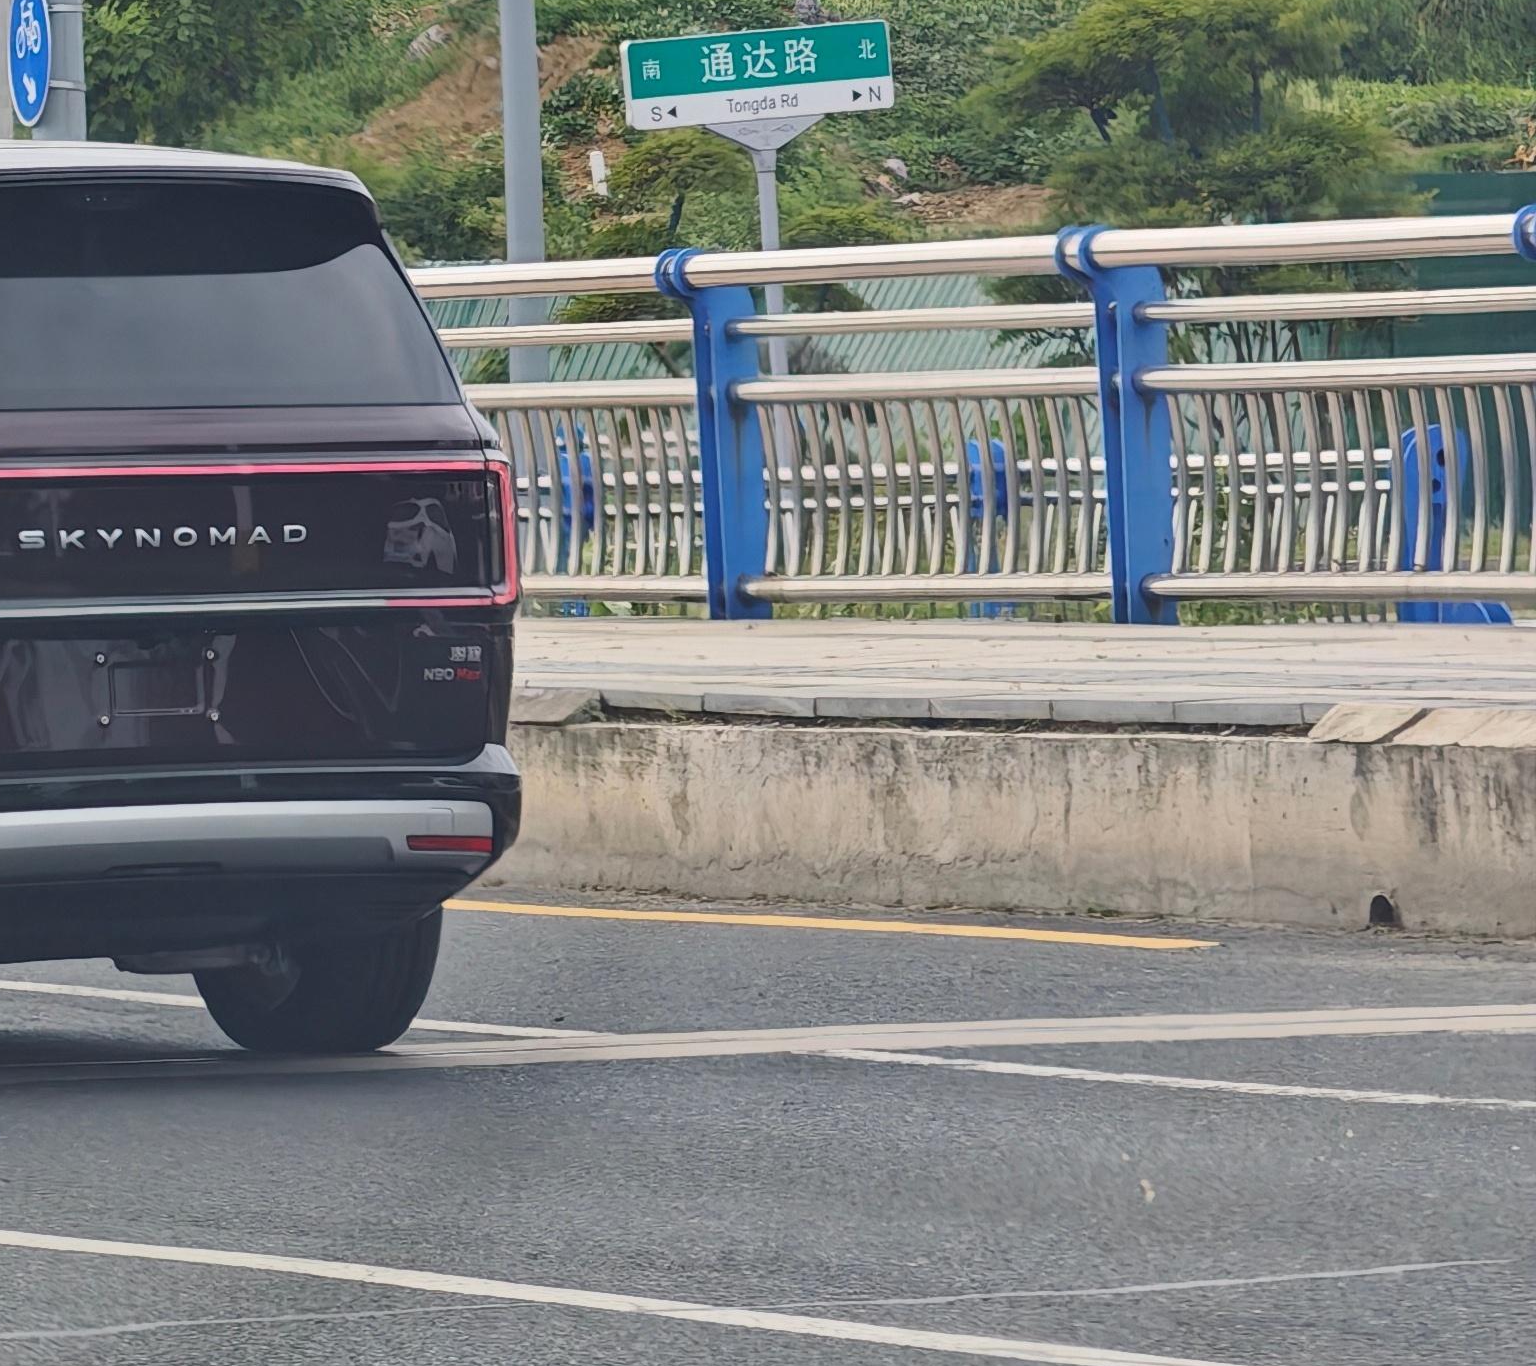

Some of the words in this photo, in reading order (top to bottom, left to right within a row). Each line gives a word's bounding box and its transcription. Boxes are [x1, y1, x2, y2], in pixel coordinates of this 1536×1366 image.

[641, 59, 661, 81] 南
[700, 36, 817, 83] 通达路
[858, 38, 877, 60] 北
[651, 106, 663, 122] S
[726, 95, 776, 115] Tongda
[781, 94, 799, 108] Rd
[869, 86, 881, 102] N
[18, 524, 307, 549] SKYNOMAD
